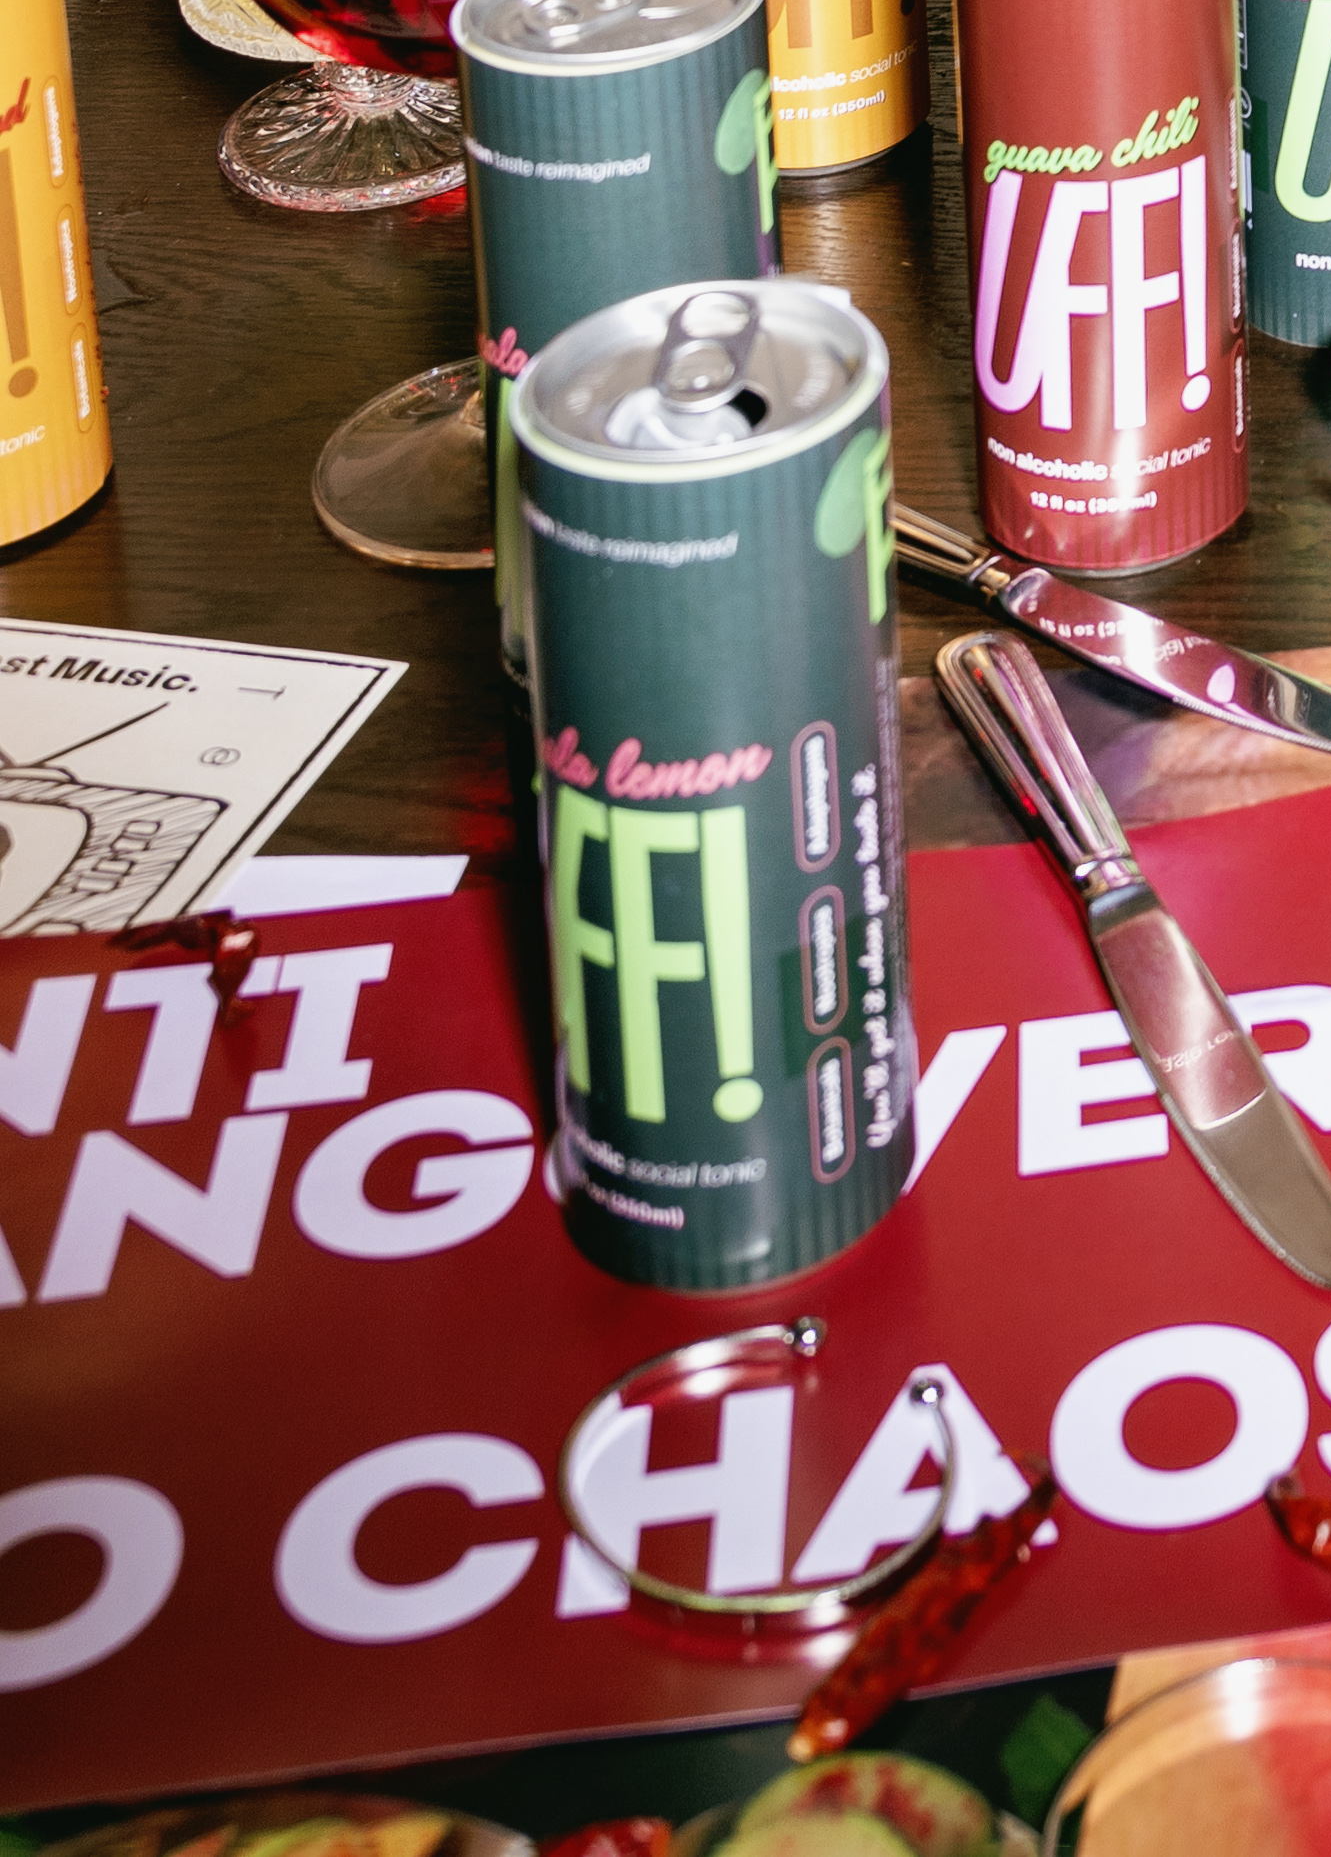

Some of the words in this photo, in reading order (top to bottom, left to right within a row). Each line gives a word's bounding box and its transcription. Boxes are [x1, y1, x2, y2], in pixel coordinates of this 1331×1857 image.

[771, 70, 847, 93] lcoholic
[849, 52, 893, 83] social
[777, 106, 795, 121] 12
[796, 105, 809, 120] fl
[810, 105, 830, 119] oz
[831, 88, 887, 119] (350ml)
[984, 139, 1102, 184] guava
[1110, 95, 1200, 169] chili
[534, 151, 651, 183] reimagined
[975, 155, 1212, 433] UFF!
[0, 424, 46, 458] tonic
[988, 437, 1016, 466] non
[1016, 451, 1109, 483] alcoholic
[1169, 437, 1212, 468] tonic
[1029, 491, 1049, 509] 12
[1049, 493, 1064, 511] fl
[1064, 499, 1087, 513] oz
[0, 654, 49, 676] st
[49, 657, 200, 694] Music.
[605, 737, 773, 801] lemon
[550, 784, 764, 1124] FF!
[699, 1156, 768, 1189] tonic
[0, 1474, 184, 1691] O
